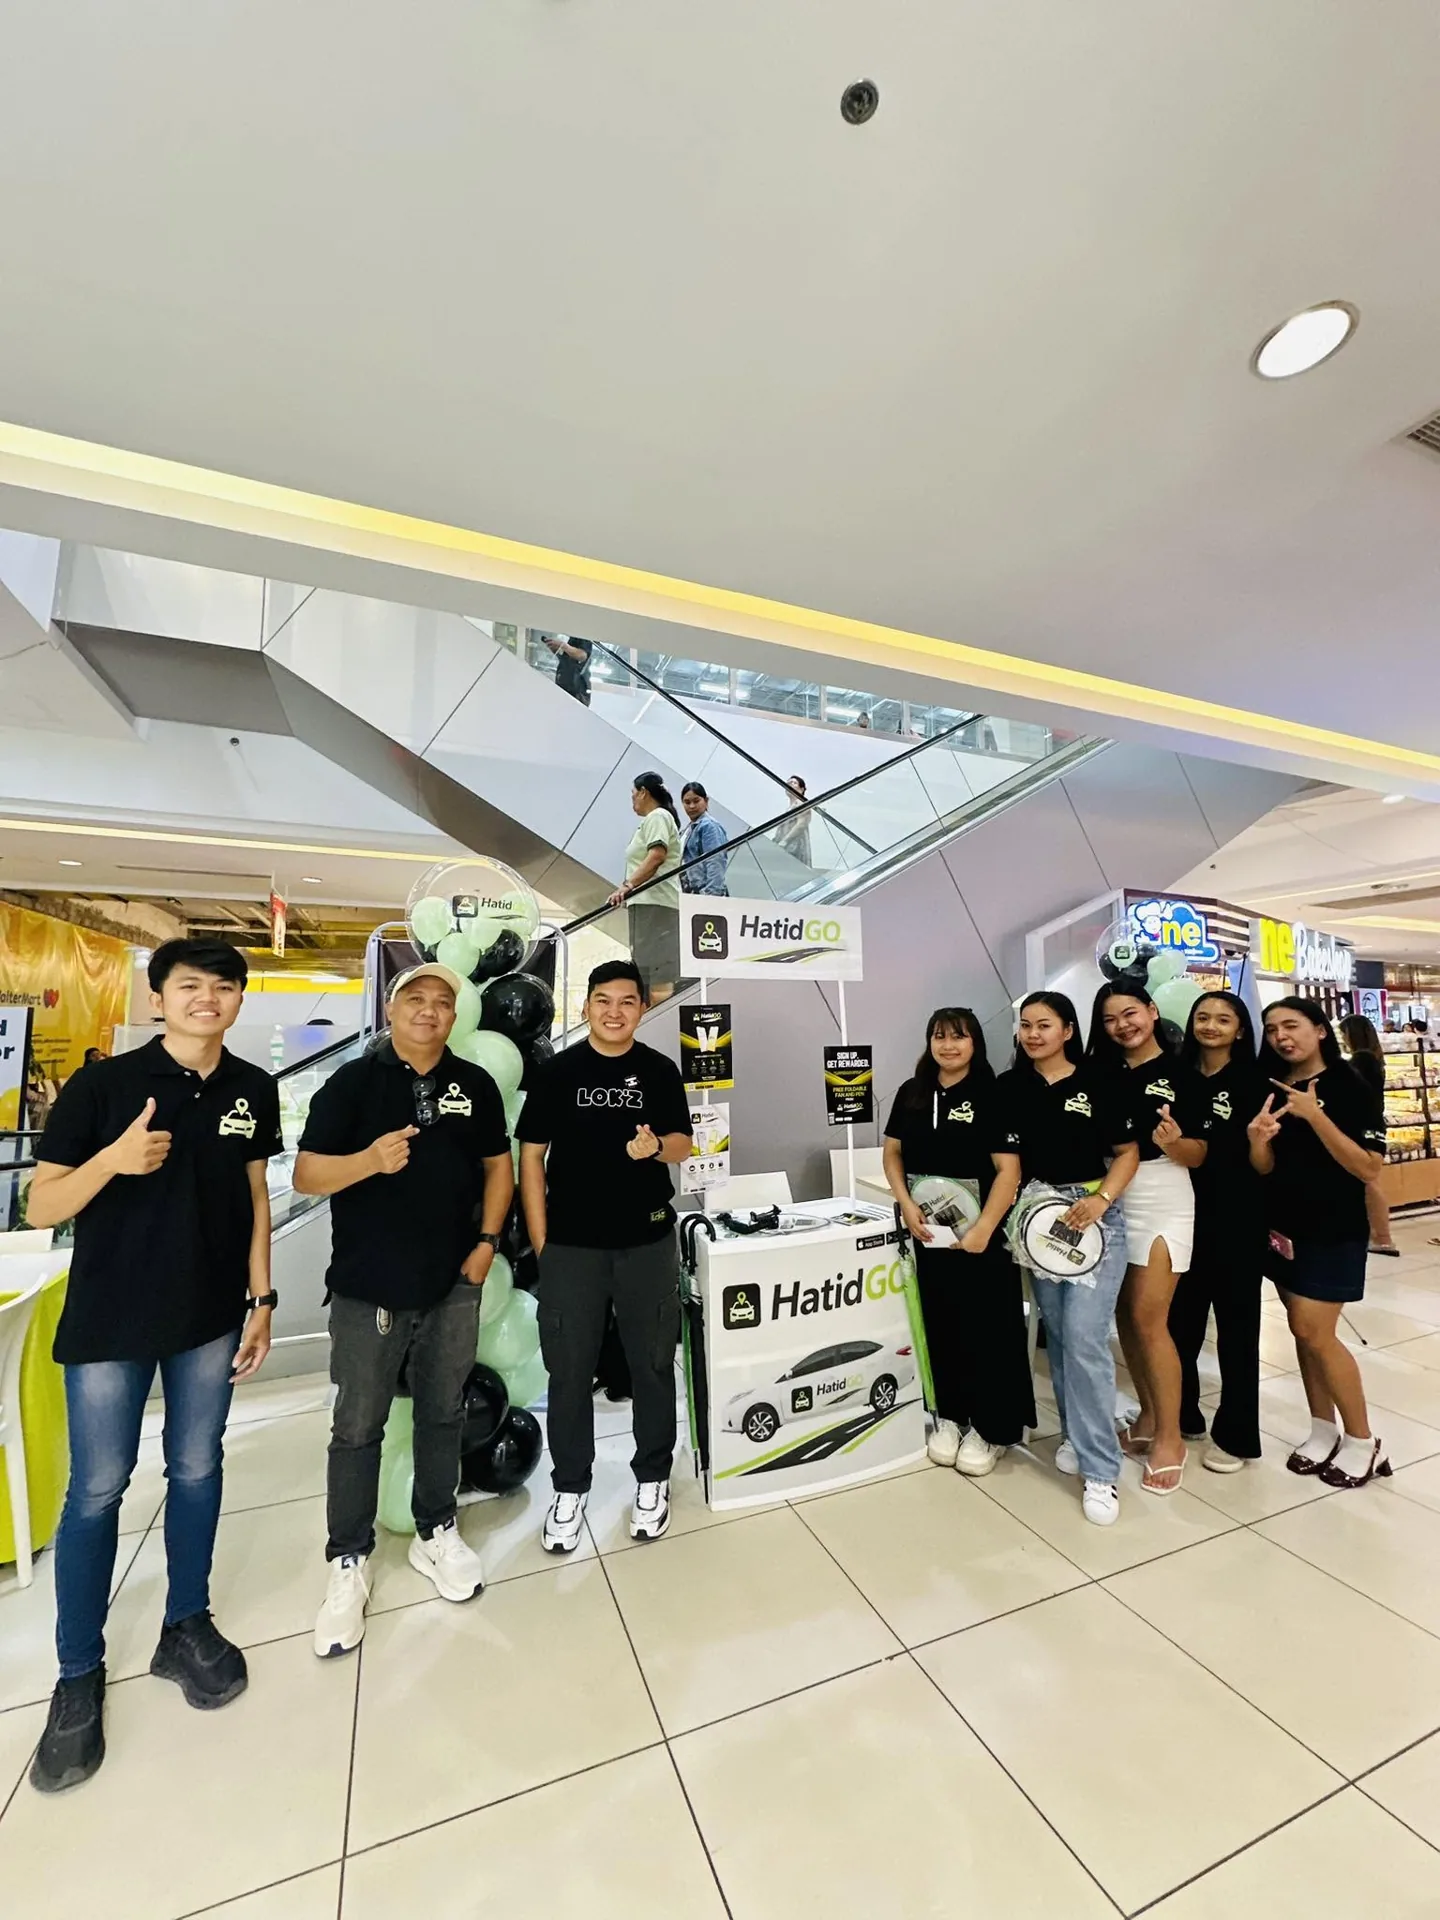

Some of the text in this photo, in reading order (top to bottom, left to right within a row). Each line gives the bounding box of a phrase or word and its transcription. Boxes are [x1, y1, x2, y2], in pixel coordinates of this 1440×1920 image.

[481, 898, 526, 912] Hatid
[739, 914, 841, 942] HatidGO
[0, 1046, 15, 1059] r
[837, 1052, 849, 1060] SIGN
[827, 1060, 837, 1068] GET
[577, 1087, 643, 1109] LOK'Z
[771, 1260, 905, 1321] HatidGO
